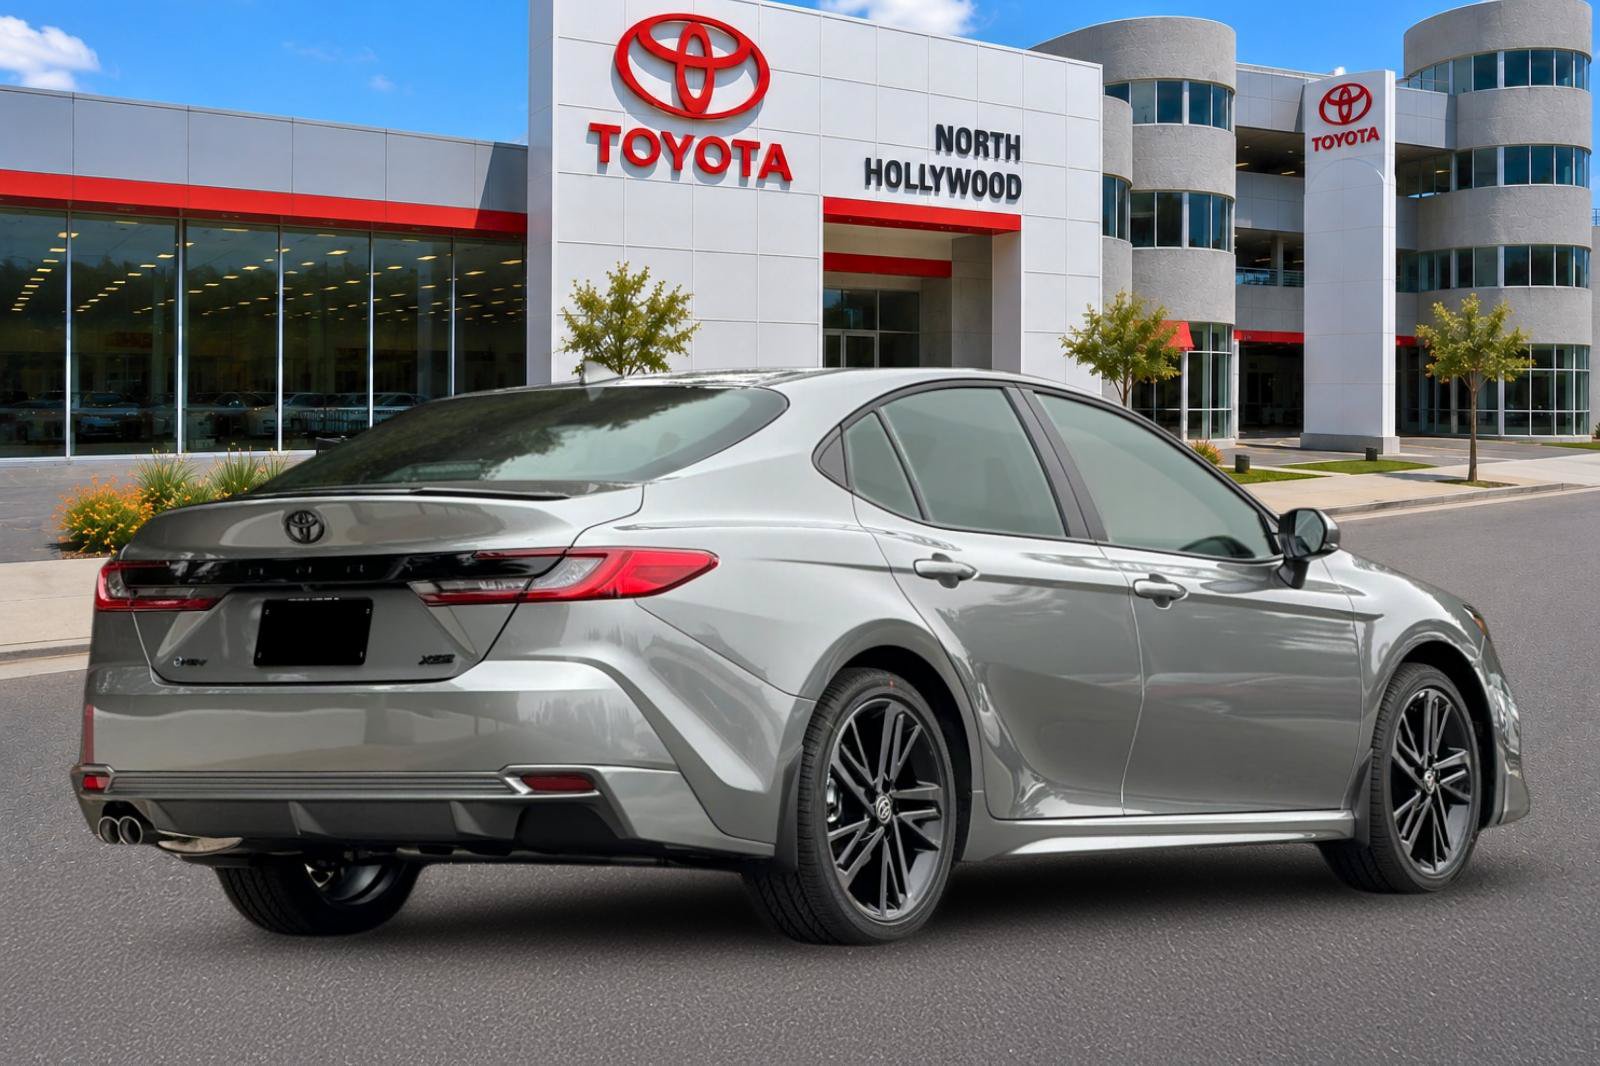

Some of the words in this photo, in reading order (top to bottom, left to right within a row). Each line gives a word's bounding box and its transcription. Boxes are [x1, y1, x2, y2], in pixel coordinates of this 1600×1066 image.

[588, 122, 793, 182] TOYOTA
[936, 124, 1021, 161] NORTH
[1311, 126, 1380, 152] TOYOTA
[865, 157, 1022, 200] HOLLYWOOD
